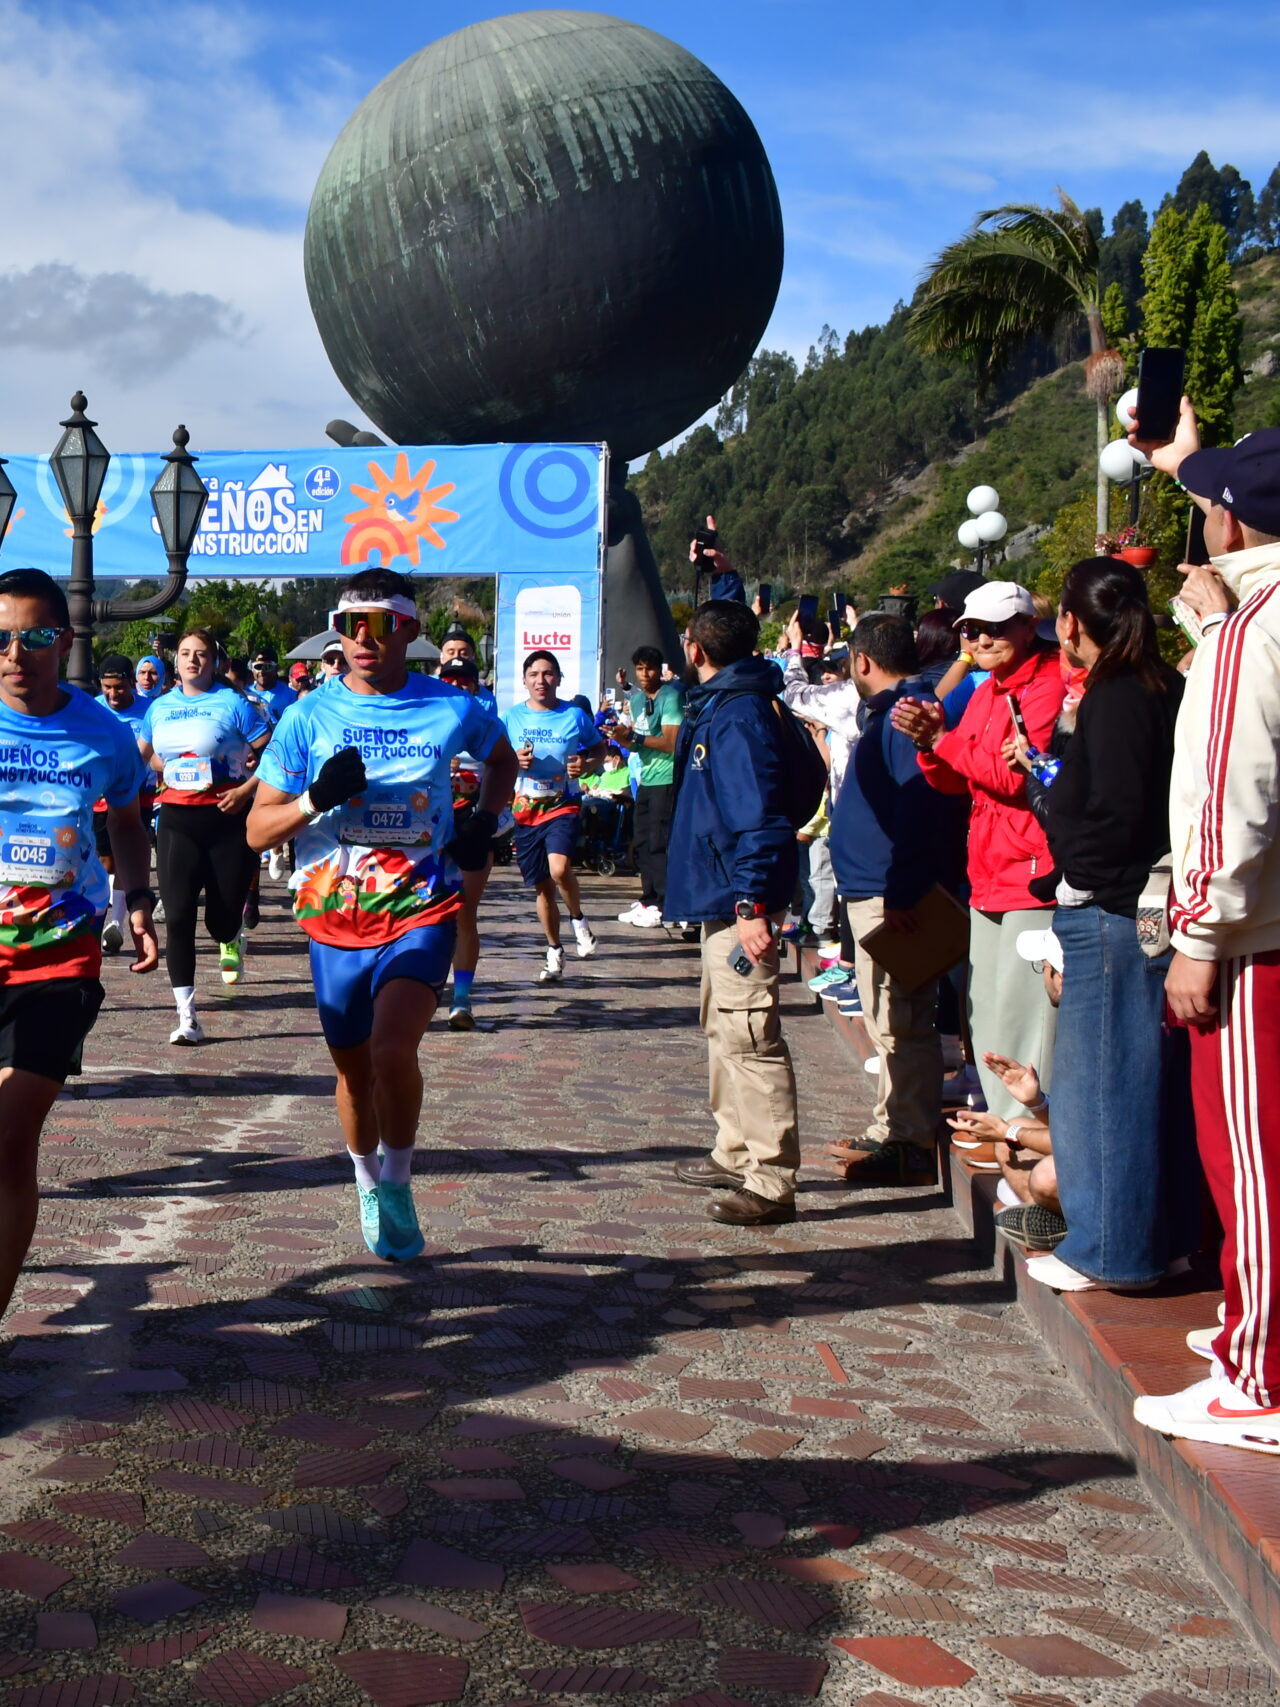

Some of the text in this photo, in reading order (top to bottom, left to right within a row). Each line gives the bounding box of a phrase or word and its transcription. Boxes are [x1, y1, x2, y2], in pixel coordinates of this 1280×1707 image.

[312, 487, 334, 496] edición
[152, 481, 322, 533] EÑOS EN
[191, 528, 308, 555] NSTRUCCIÓN
[523, 631, 571, 645] Lucta
[343, 726, 409, 746] SUEÑOS
[371, 812, 404, 827] 0472
[10, 845, 48, 864] 0045
